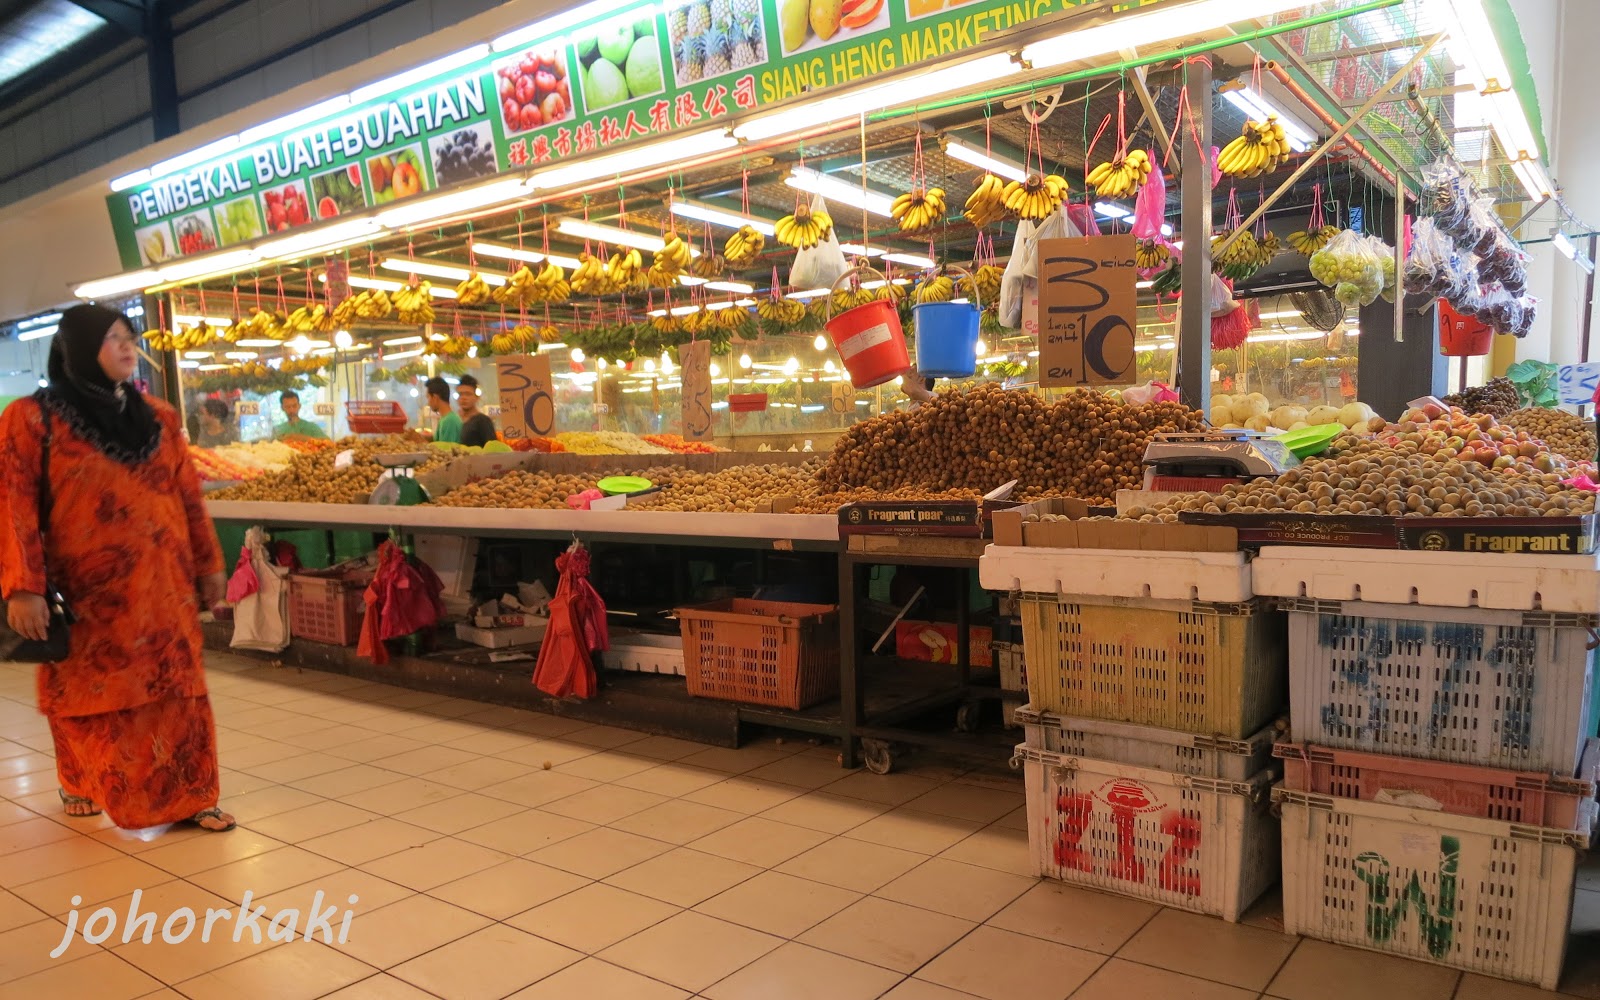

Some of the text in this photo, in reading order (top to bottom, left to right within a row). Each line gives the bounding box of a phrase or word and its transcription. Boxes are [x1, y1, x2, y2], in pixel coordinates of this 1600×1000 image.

[761, 57, 826, 104] SIANG
[830, 38, 896, 85] HENG
[128, 73, 487, 225] PEMBEKAL BUAH-BUAHAN
[507, 74, 757, 166] 祥興市場私人有限公司
[1044, 256, 1110, 314] 3
[1076, 313, 1135, 384] 10
[499, 363, 532, 393] 3
[521, 389, 554, 438] 10
[868, 509, 943, 522] Fragrant pear
[1464, 533, 1571, 553] Fragrant
